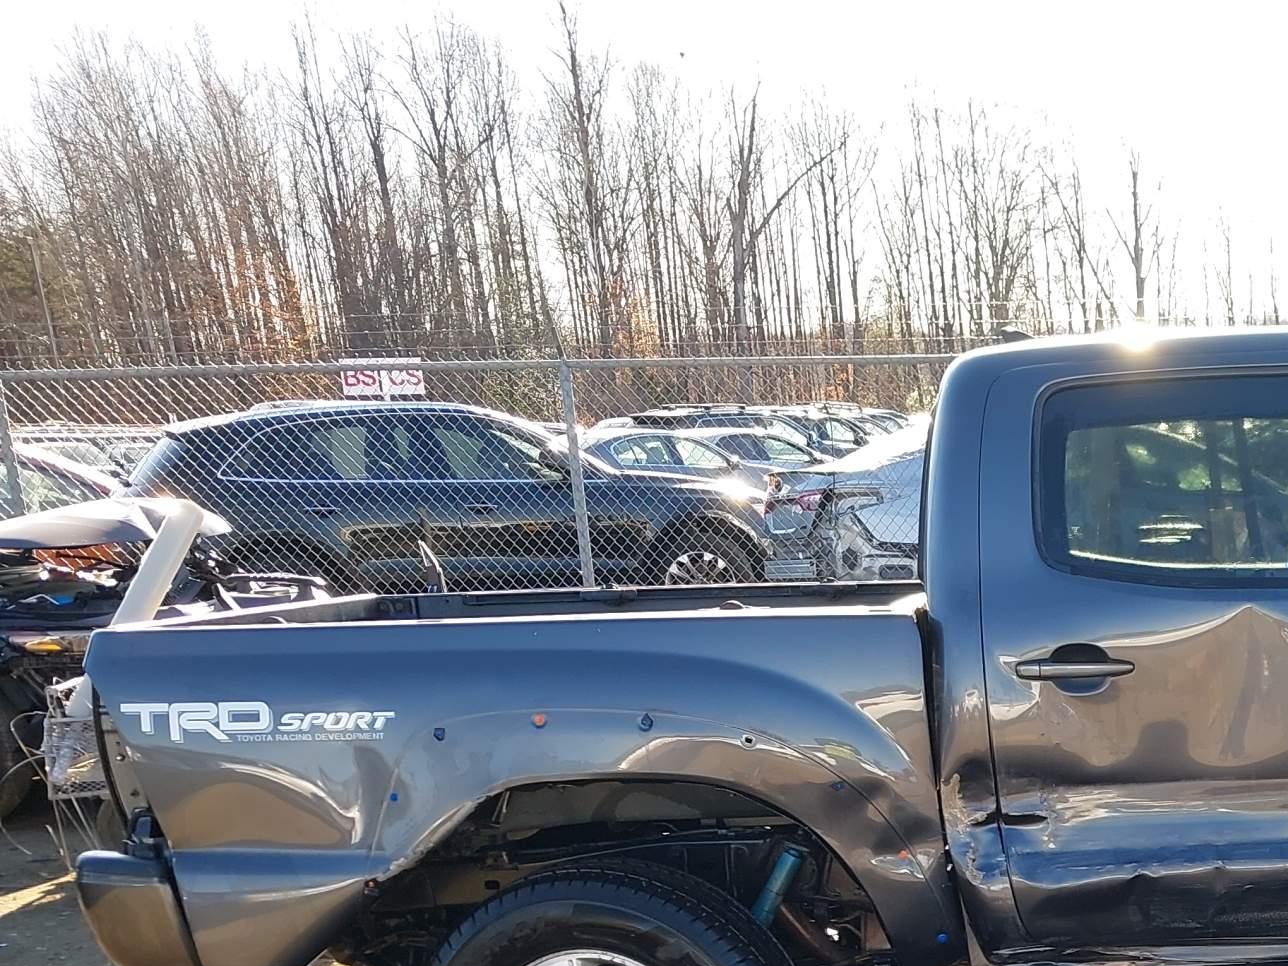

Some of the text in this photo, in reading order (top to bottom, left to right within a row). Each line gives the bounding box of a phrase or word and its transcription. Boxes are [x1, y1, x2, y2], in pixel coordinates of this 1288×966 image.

[343, 369, 377, 387] BS
[119, 701, 396, 743] TRD SPORT
[237, 732, 385, 742] TOYOTA RACING DEVELOPMENT
